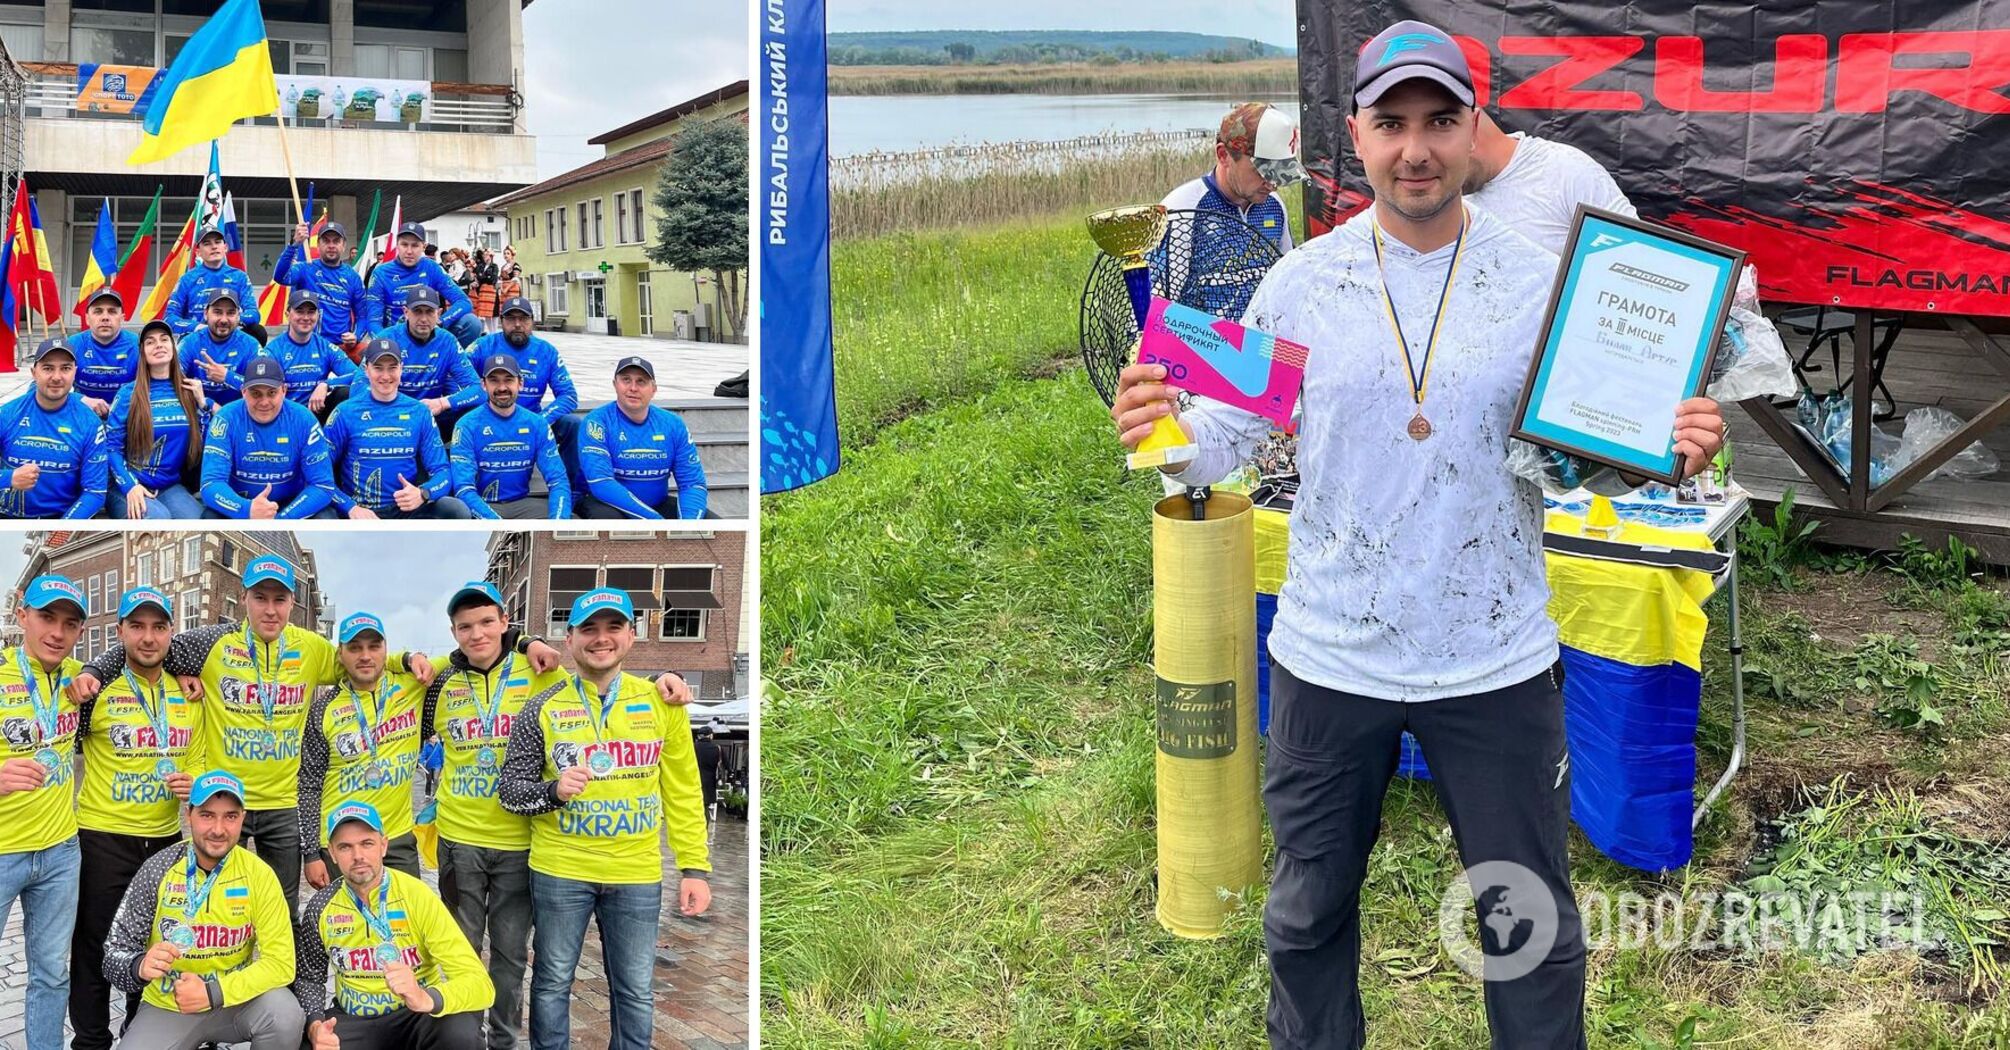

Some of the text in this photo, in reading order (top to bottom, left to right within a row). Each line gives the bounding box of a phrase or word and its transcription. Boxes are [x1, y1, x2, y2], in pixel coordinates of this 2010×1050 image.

[765, 42, 788, 246] РИБАЛЬСЬКИЙ
[1611, 263, 1687, 291] FLAGMAN
[1597, 290, 1677, 327] ГРАМОТА
[1152, 323, 1220, 352] СЕРТИФИКАТ
[1156, 313, 1230, 345] ПОДАРОЧНЫЙ
[1598, 316, 1613, 331] ЗА
[1626, 324, 1665, 345] МІСЦЕ
[13, 439, 70, 452] ACROPOLIS
[242, 455, 290, 463] ACROPOLIS
[482, 444, 531, 452] ACROPOLIS
[617, 452, 668, 460] ACROPOLIS
[236, 470, 294, 480] AZURA
[479, 460, 532, 469] AZURA
[559, 807, 659, 837] UKRAINE
